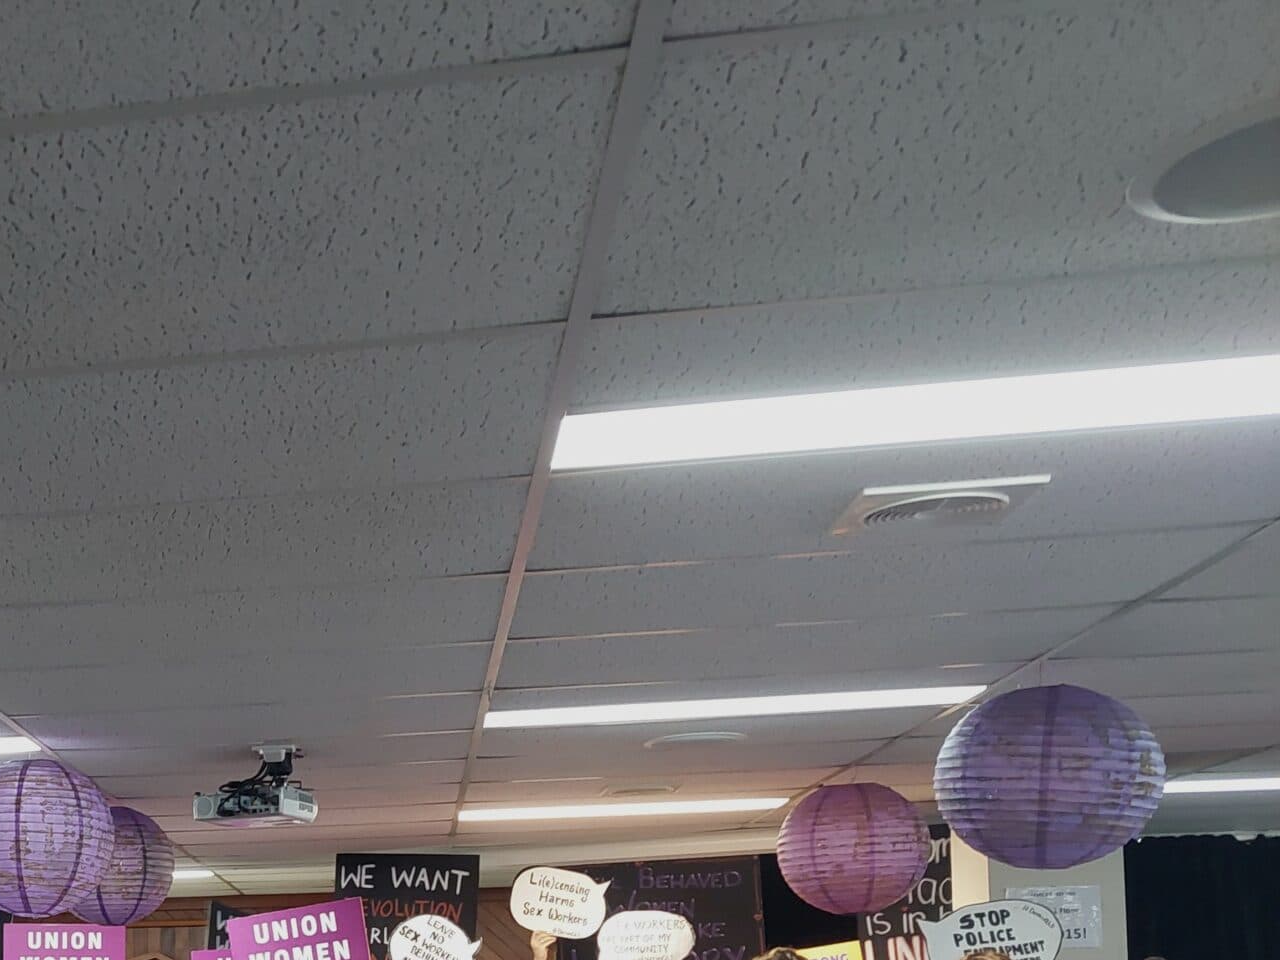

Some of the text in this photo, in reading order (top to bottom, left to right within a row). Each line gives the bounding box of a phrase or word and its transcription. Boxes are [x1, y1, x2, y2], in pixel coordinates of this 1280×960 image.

[340, 864, 469, 896] WE WANT
[529, 871, 591, 903] Li(e)censing
[639, 867, 742, 889] BEHAVED
[538, 890, 575, 908] Harms
[523, 901, 588, 926] Sex Workers
[865, 913, 892, 936] IS
[959, 909, 1011, 931] STOP
[253, 911, 337, 944] UNION
[399, 925, 421, 943] SEX
[427, 915, 456, 938] LEAVE
[429, 931, 445, 944] NO
[698, 922, 727, 940] KE
[953, 927, 1016, 948] POLICE
[27, 931, 103, 950] UNION
